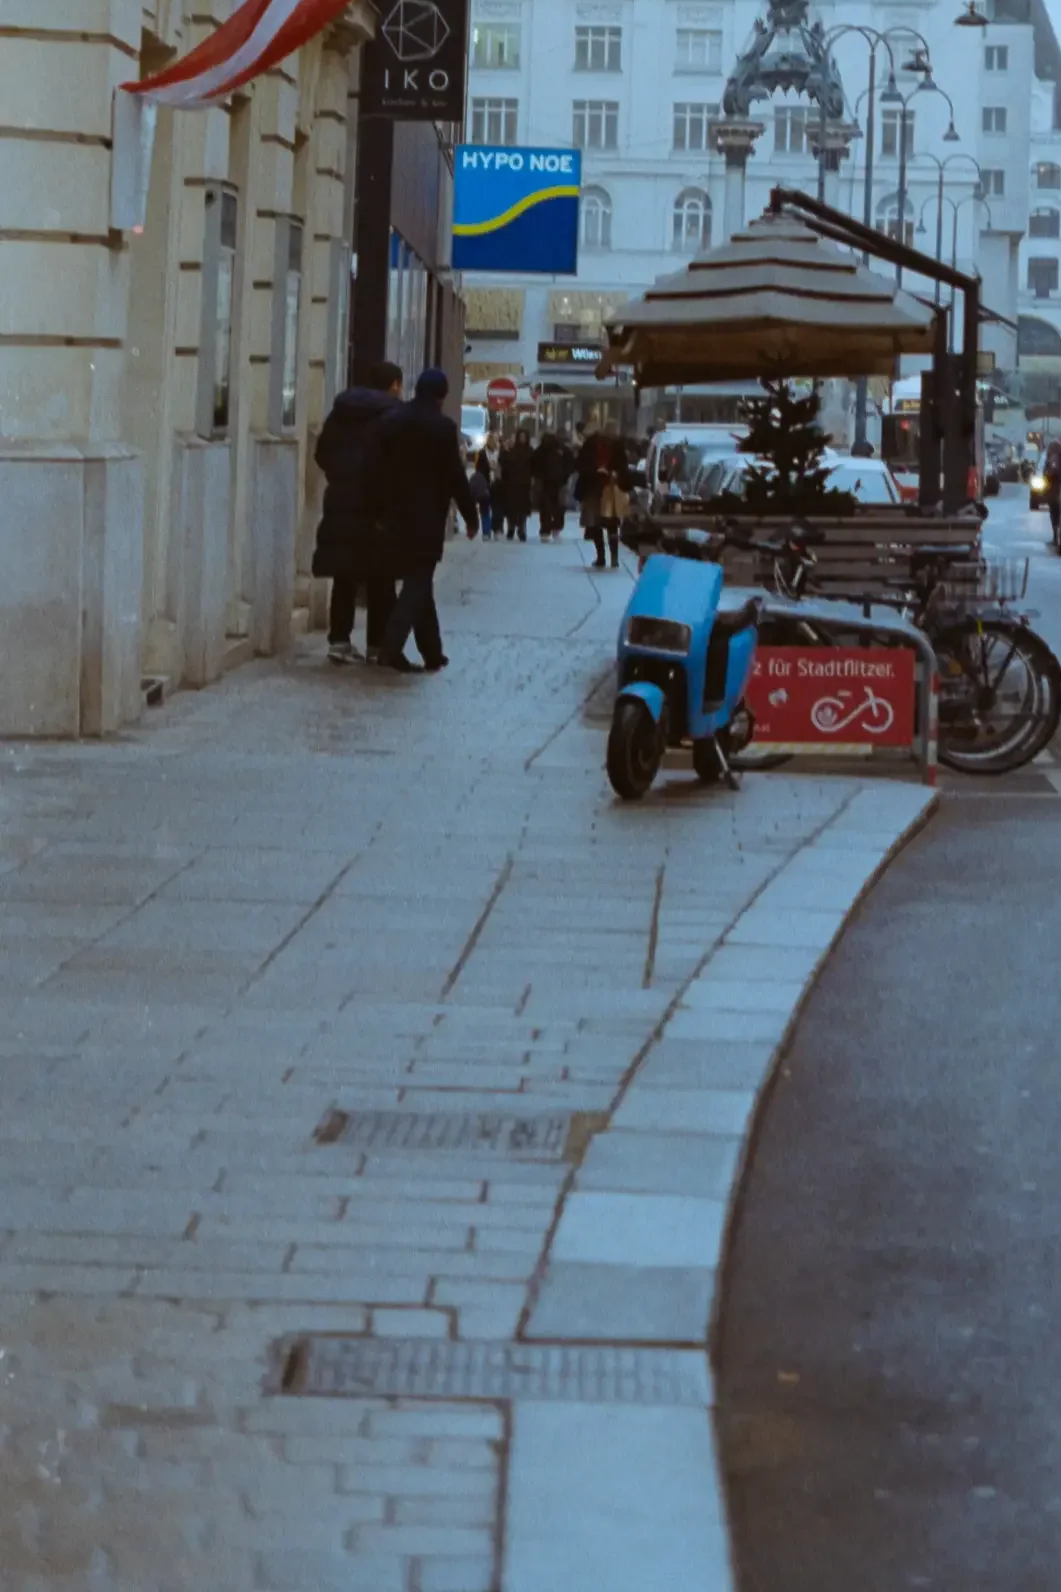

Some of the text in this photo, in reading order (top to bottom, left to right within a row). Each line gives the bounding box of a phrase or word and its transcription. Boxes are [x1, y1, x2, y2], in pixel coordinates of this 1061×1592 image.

[384, 68, 449, 90] IKO
[462, 151, 573, 173] HYPO NOE
[768, 657, 792, 677] für
[798, 658, 895, 677] Stadtflitzer.
